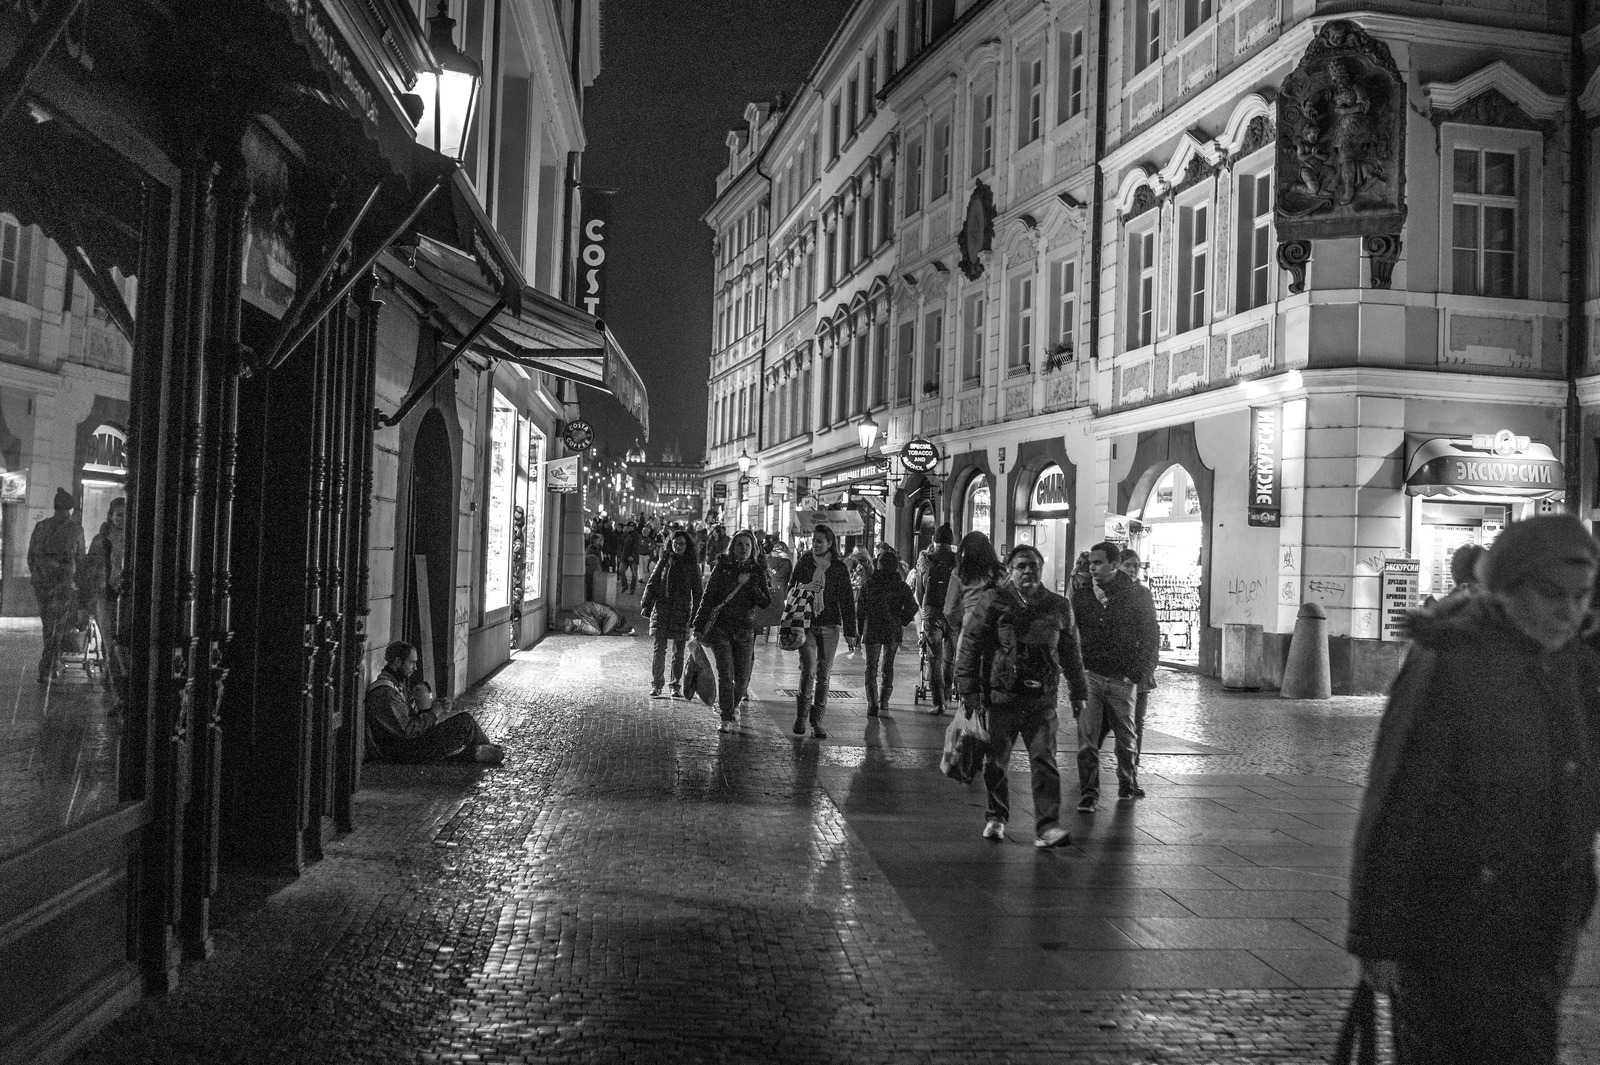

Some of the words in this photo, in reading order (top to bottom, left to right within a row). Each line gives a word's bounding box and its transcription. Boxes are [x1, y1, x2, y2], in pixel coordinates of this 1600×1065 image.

[583, 219, 605, 315] COST
[569, 423, 588, 431] COSTA
[567, 437, 590, 449] COFFEE
[907, 449, 934, 457] TOBACCO
[1257, 410, 1274, 505] ЭКСКУРСИИ
[902, 456, 924, 471] ALCOHOL
[1456, 461, 1552, 484] ЭКСКУРСИИ
[1385, 563, 1419, 572] ЭКСКУРСИИ
